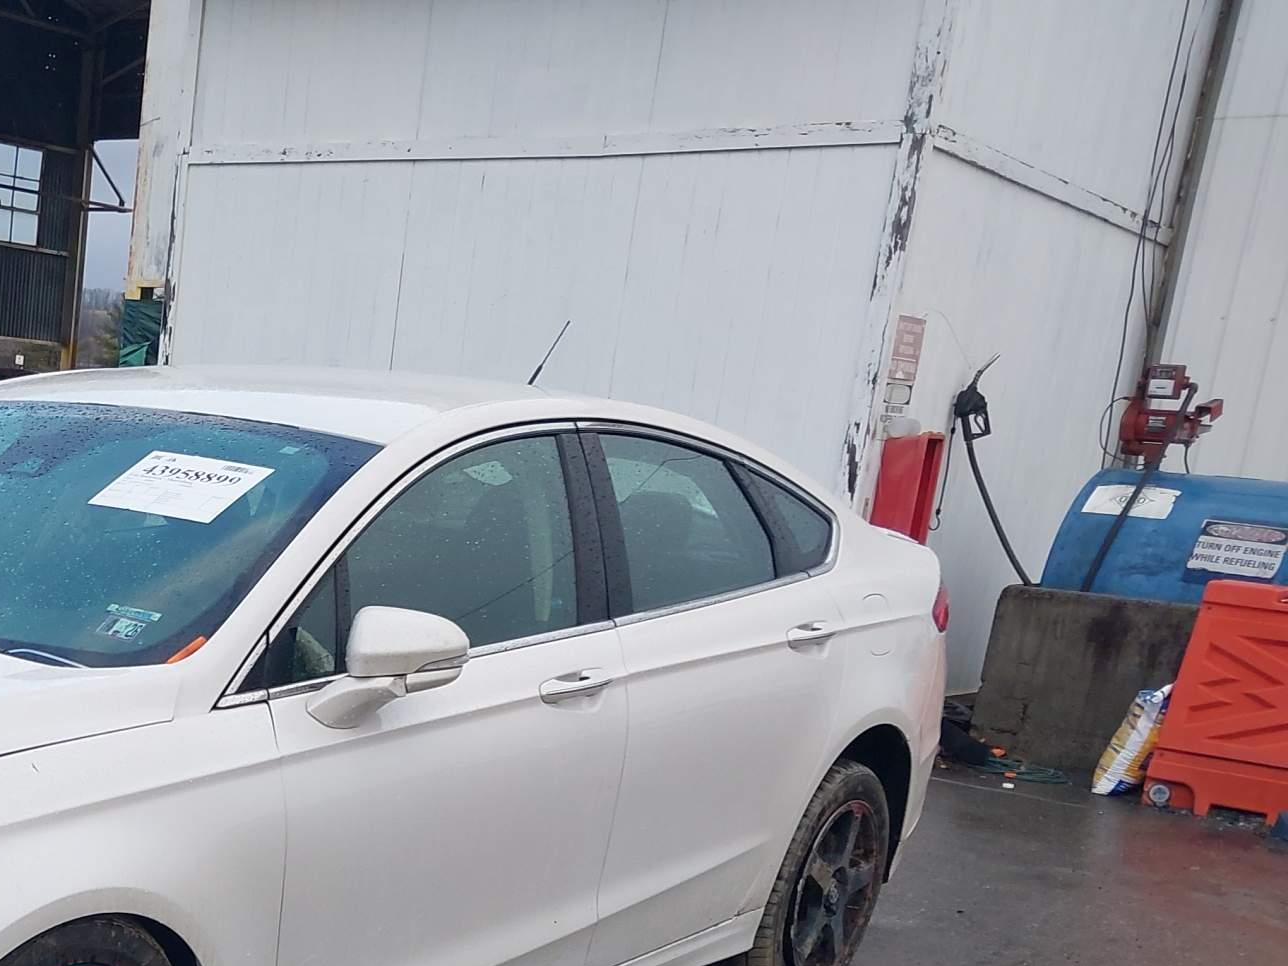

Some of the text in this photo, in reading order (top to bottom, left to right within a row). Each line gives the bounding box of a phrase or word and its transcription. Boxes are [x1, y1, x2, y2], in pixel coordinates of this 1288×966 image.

[143, 465, 242, 486] 43958899
[1197, 541, 1282, 558] TURN OFF ENGINE
[1192, 553, 1276, 571] WHILE REFUELING
